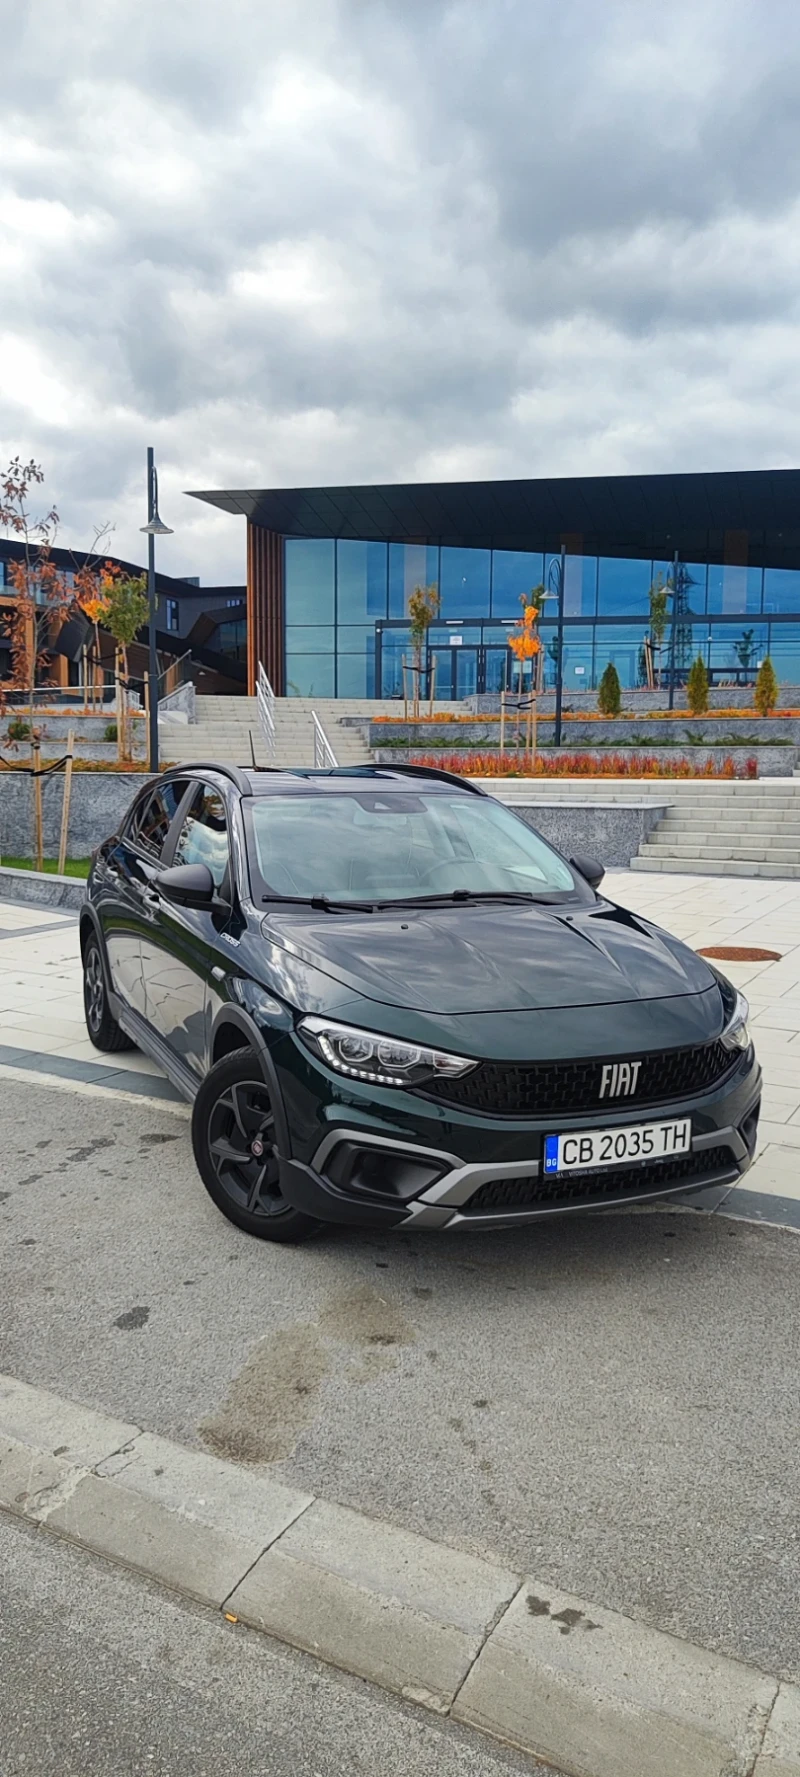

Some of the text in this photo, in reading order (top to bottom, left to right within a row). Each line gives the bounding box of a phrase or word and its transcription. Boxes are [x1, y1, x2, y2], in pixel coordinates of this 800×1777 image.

[599, 1061, 642, 1099] FIAT
[546, 1158, 557, 1167] BG
[563, 1123, 687, 1165] CB 2035 TH
